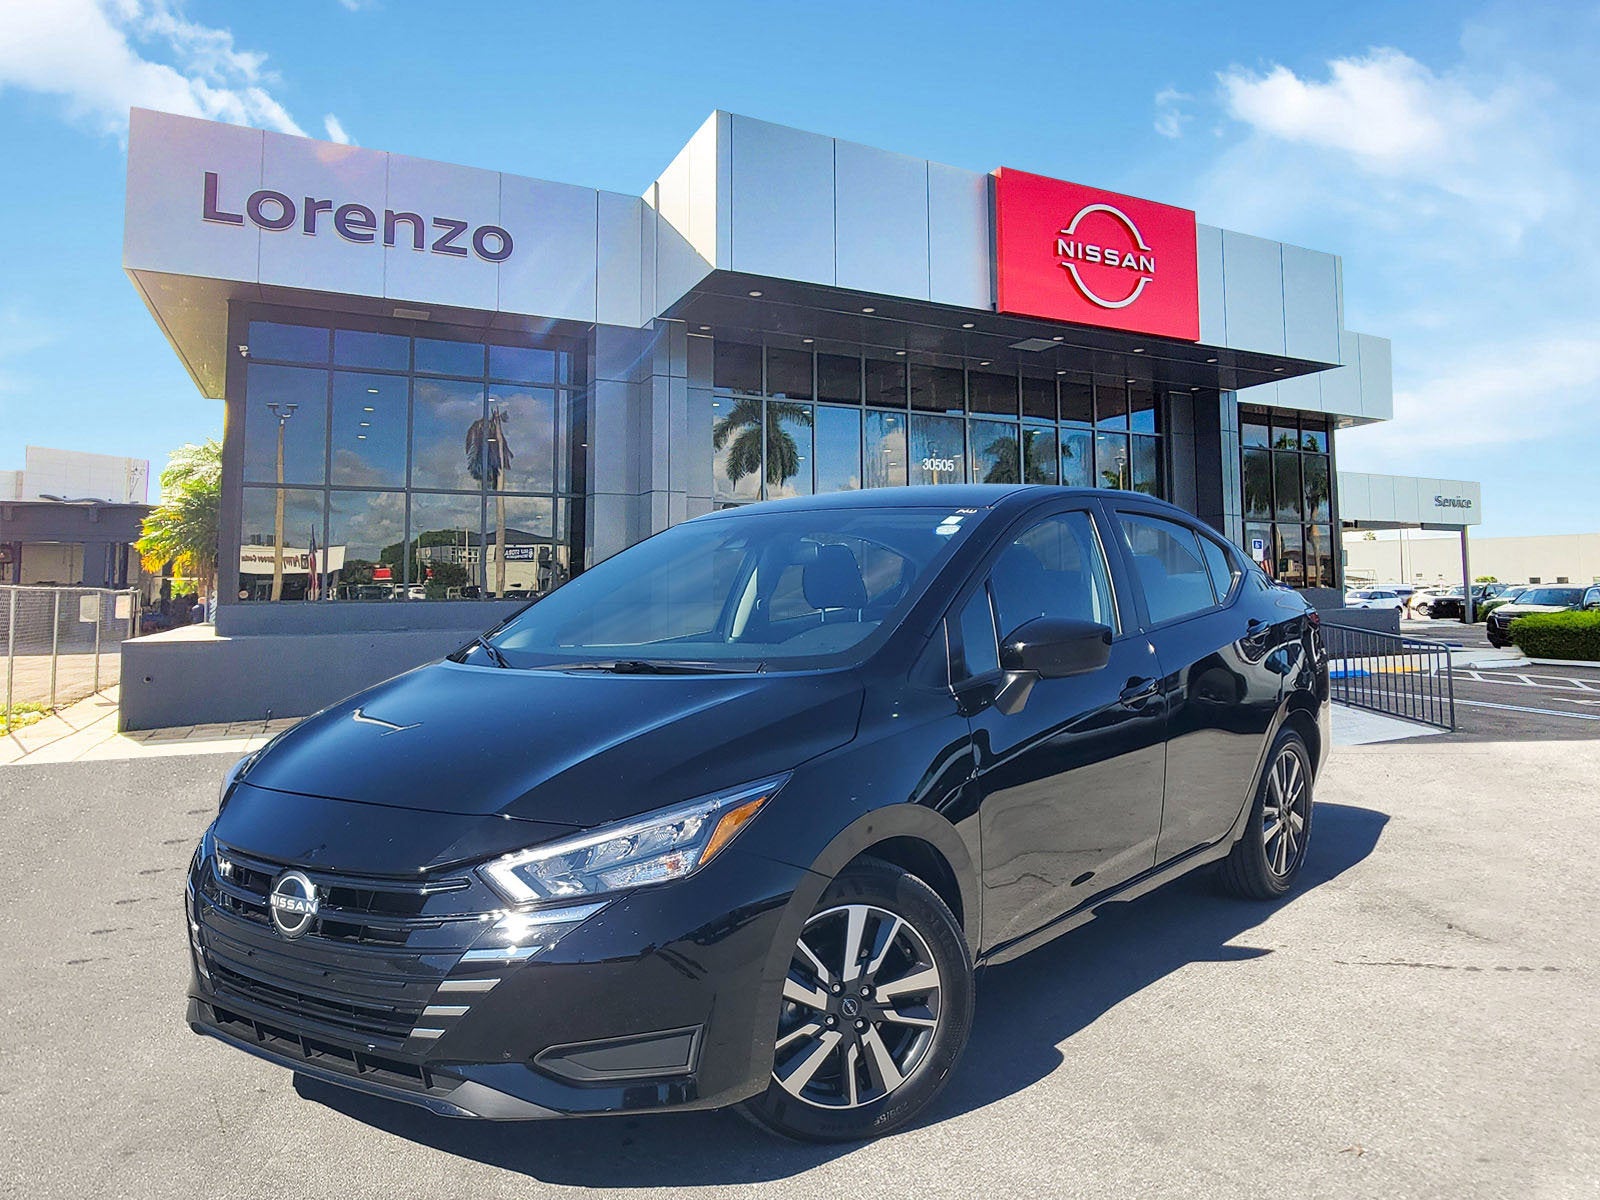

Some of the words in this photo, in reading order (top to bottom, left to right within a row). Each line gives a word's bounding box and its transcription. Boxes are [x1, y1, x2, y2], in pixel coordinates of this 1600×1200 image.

[202, 171, 514, 262] Lorenzo
[1057, 238, 1155, 273] NISSAN
[922, 458, 954, 472] 30505
[1434, 495, 1472, 508] Service
[270, 894, 317, 913] NISSAN
